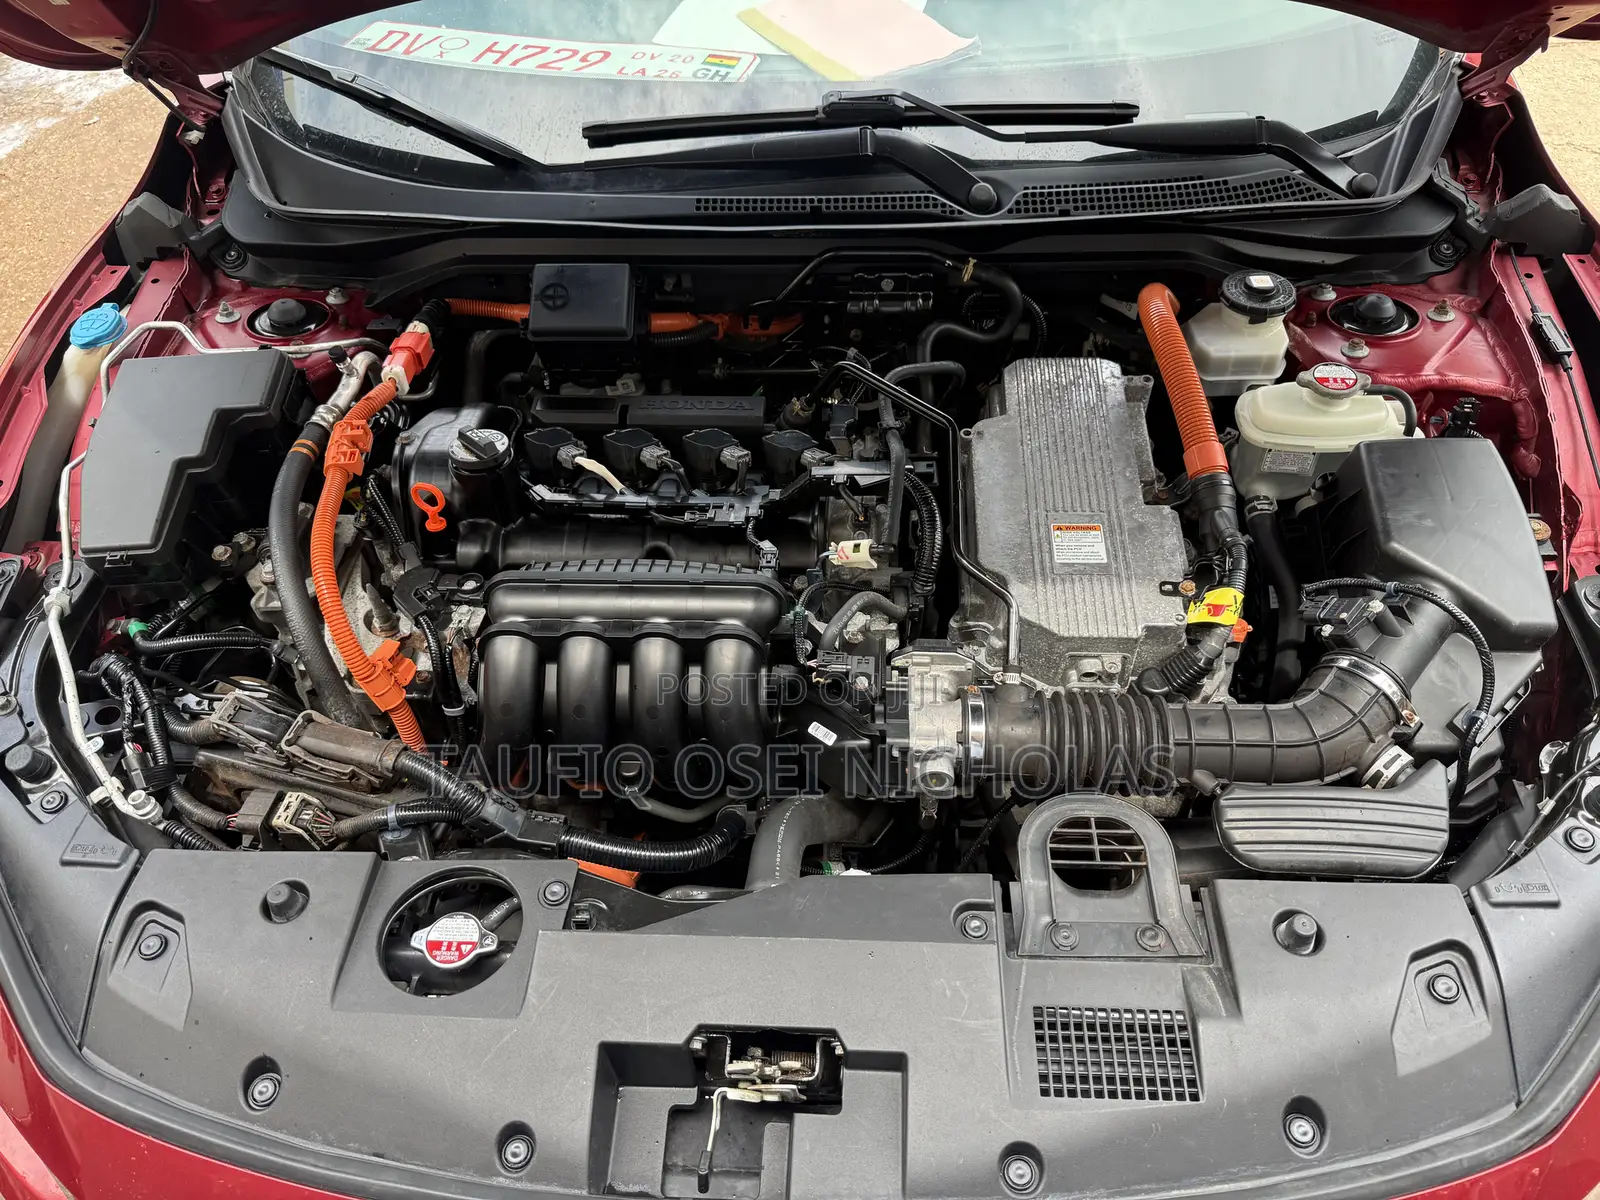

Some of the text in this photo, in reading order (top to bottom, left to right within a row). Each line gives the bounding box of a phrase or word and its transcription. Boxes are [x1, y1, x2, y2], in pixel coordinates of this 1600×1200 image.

[365, 29, 612, 72] DV H729
[630, 51, 696, 65] DV 20
[616, 66, 682, 80] LA 26
[691, 68, 731, 82] GH
[638, 400, 754, 410] HONDA
